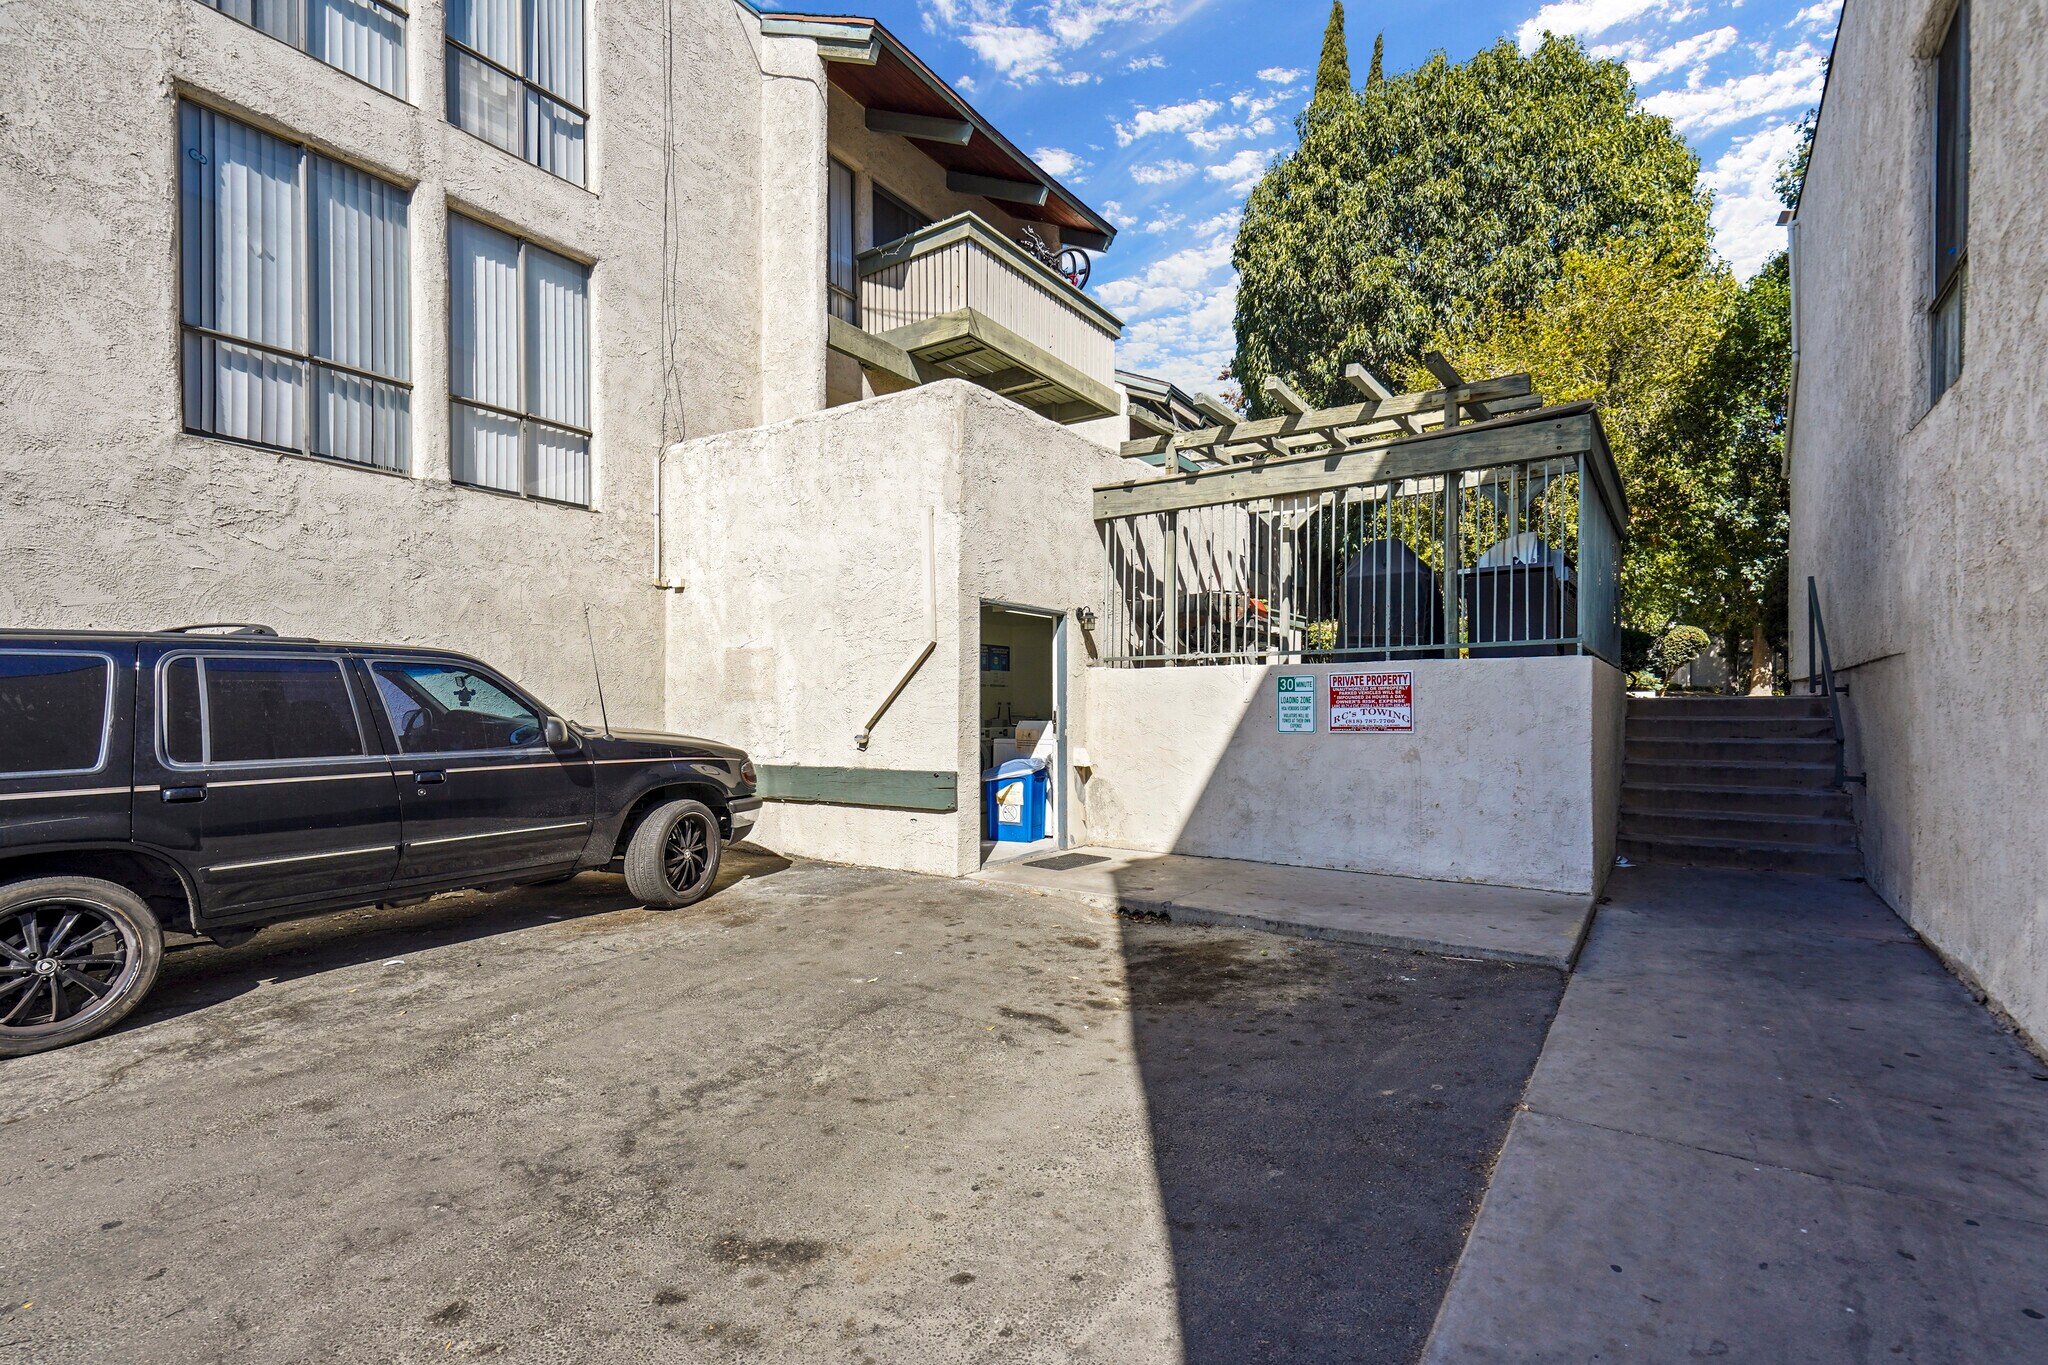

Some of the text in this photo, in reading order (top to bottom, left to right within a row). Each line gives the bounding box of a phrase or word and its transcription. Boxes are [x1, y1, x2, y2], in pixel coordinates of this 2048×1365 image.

[1280, 679, 1294, 690] 30
[1332, 674, 1408, 686] PRIVATE PROPERTY
[1334, 708, 1410, 724] RC's TOWING
